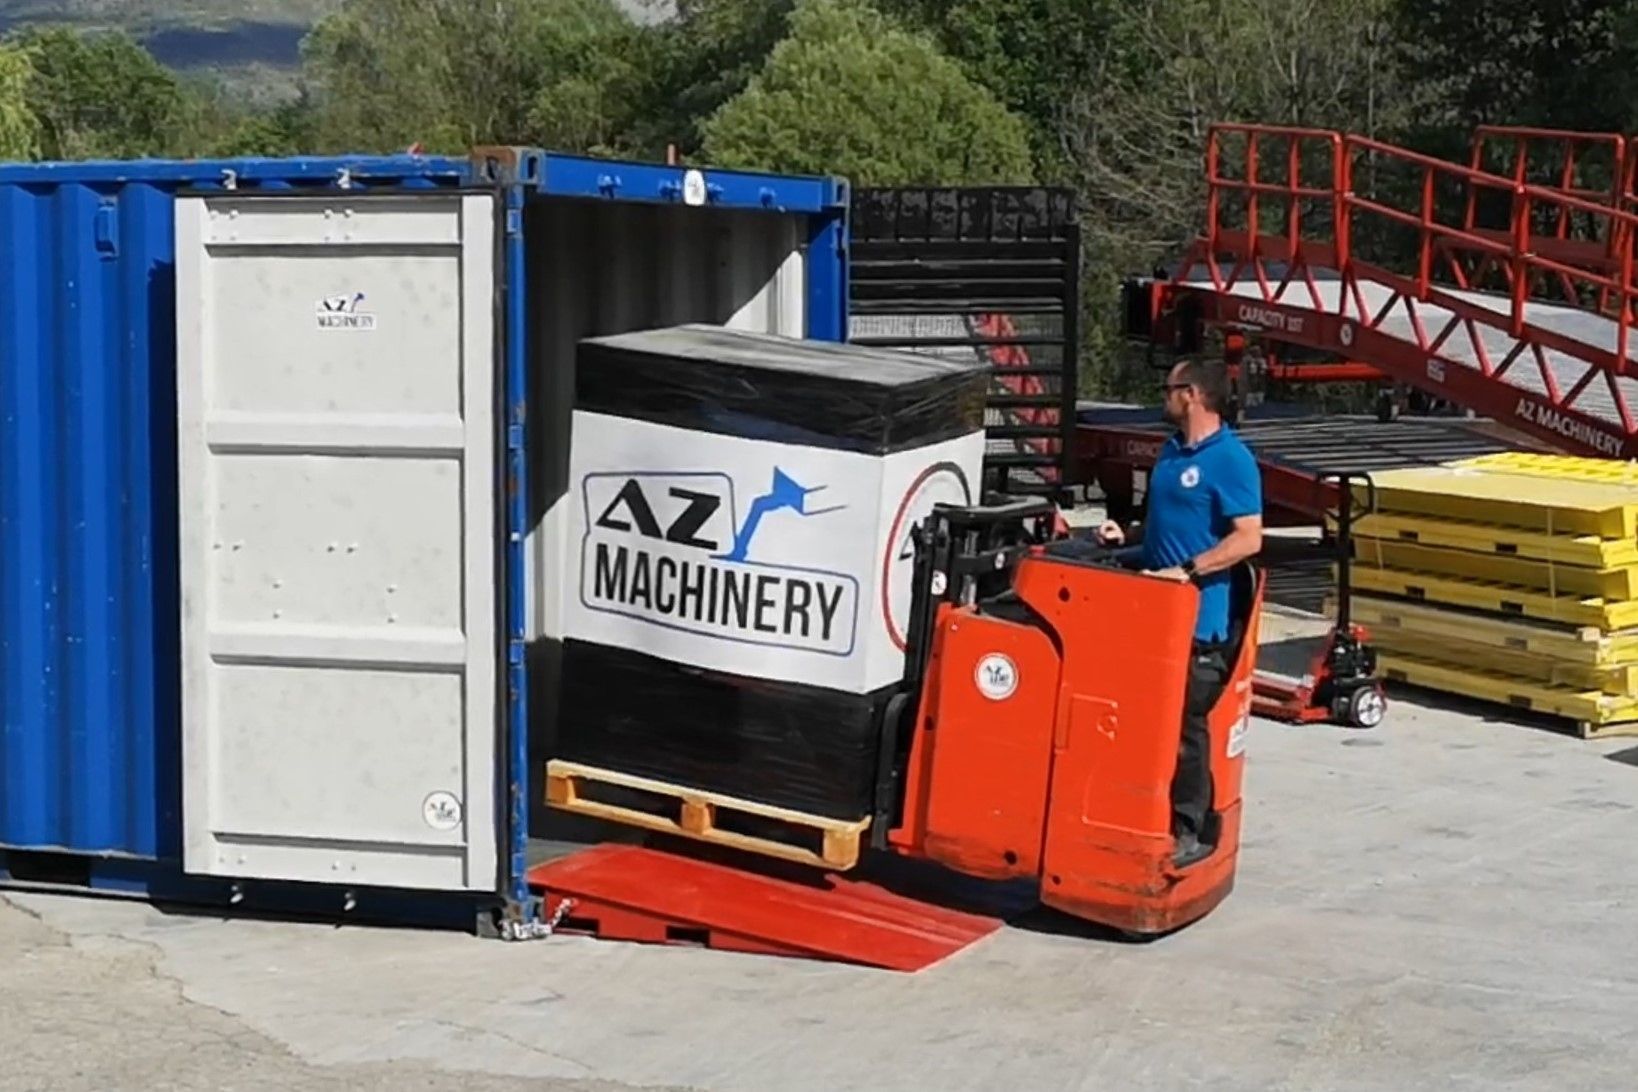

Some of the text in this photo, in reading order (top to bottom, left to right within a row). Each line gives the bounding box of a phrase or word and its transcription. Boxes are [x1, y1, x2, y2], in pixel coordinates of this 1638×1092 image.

[1514, 398, 1624, 457] AZ MACHINERY
[596, 478, 721, 551] AZ
[594, 543, 843, 641] MACHINERY
